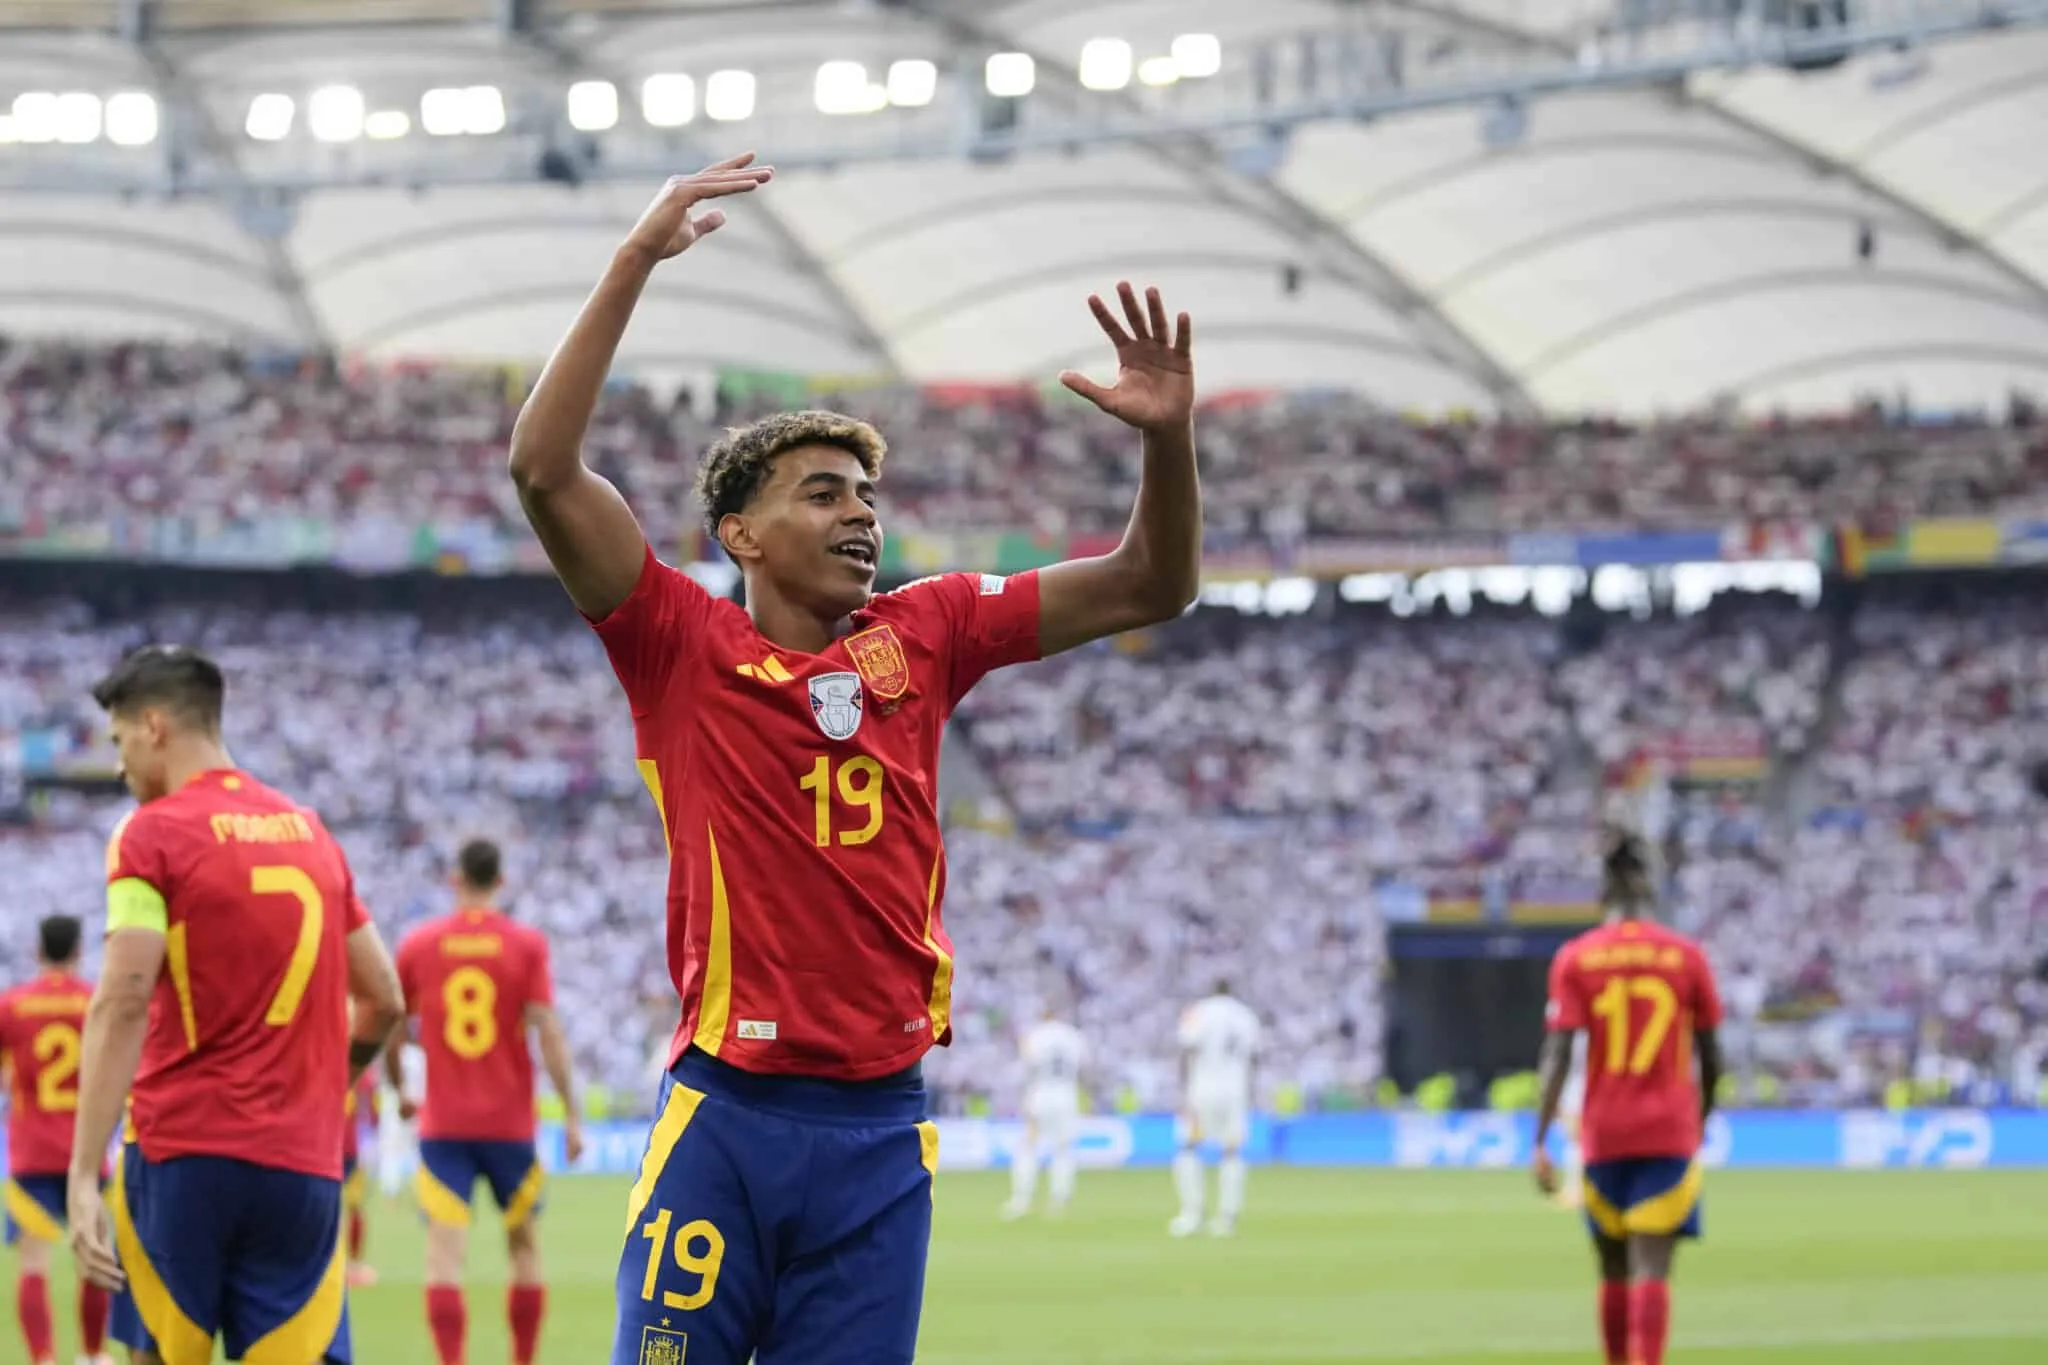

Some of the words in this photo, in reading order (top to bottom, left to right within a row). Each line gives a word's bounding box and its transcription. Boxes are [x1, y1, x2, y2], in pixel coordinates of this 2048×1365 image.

[799, 755, 884, 848] 19
[251, 865, 324, 1027] 7
[443, 965, 498, 1058] 8
[1592, 974, 1679, 1075] 17
[33, 1021, 80, 1112] 2
[641, 1208, 726, 1311] 19
